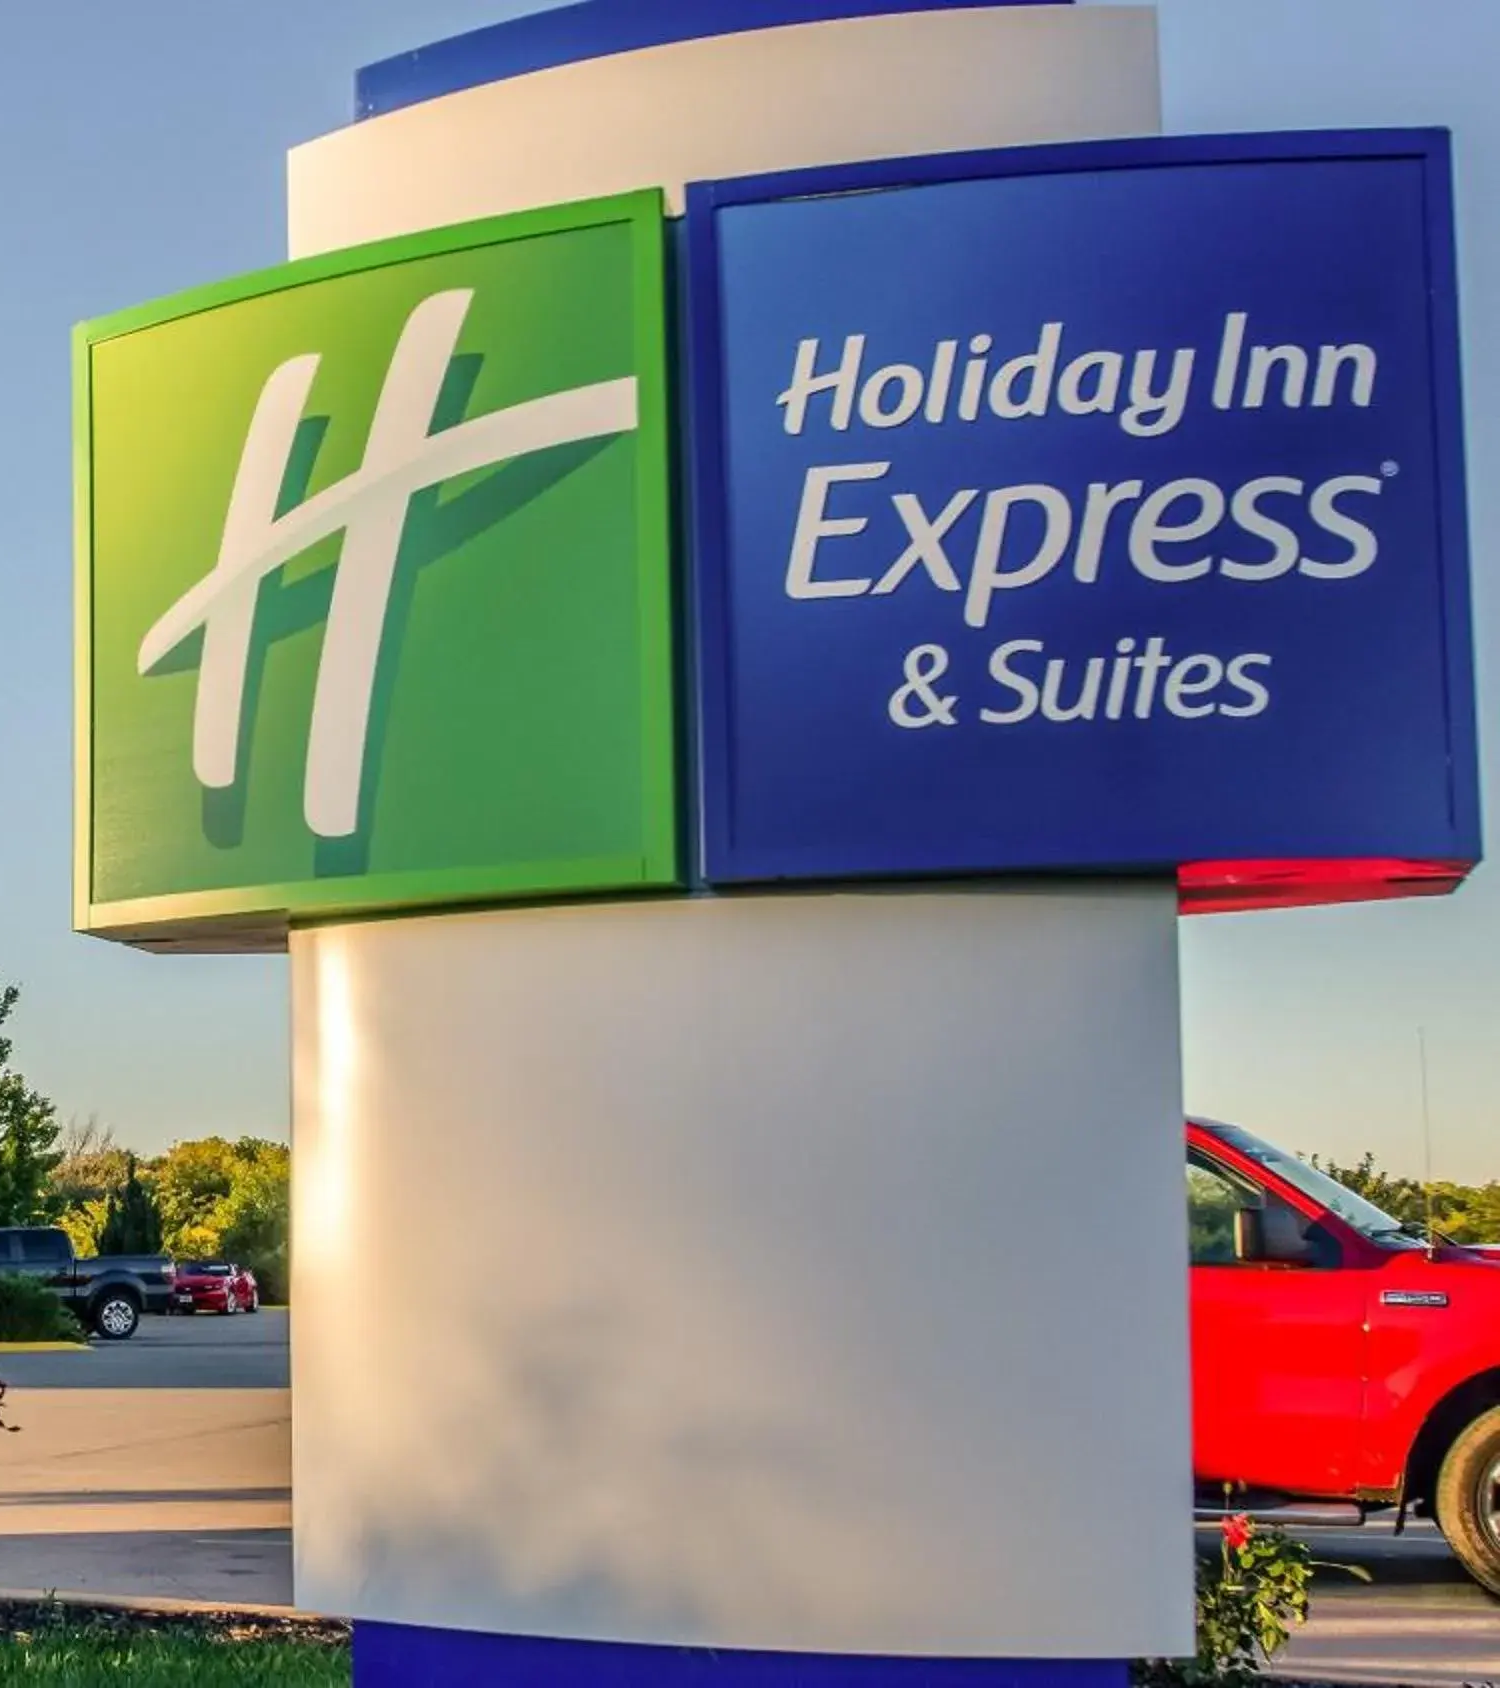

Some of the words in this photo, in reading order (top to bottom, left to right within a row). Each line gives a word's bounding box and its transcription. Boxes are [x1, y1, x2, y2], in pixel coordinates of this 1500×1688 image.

[775, 321, 1196, 437] Holiday
[1211, 311, 1377, 410] Inn
[784, 461, 1382, 628] Express
[888, 643, 959, 729] &
[978, 637, 1272, 725] Suites
